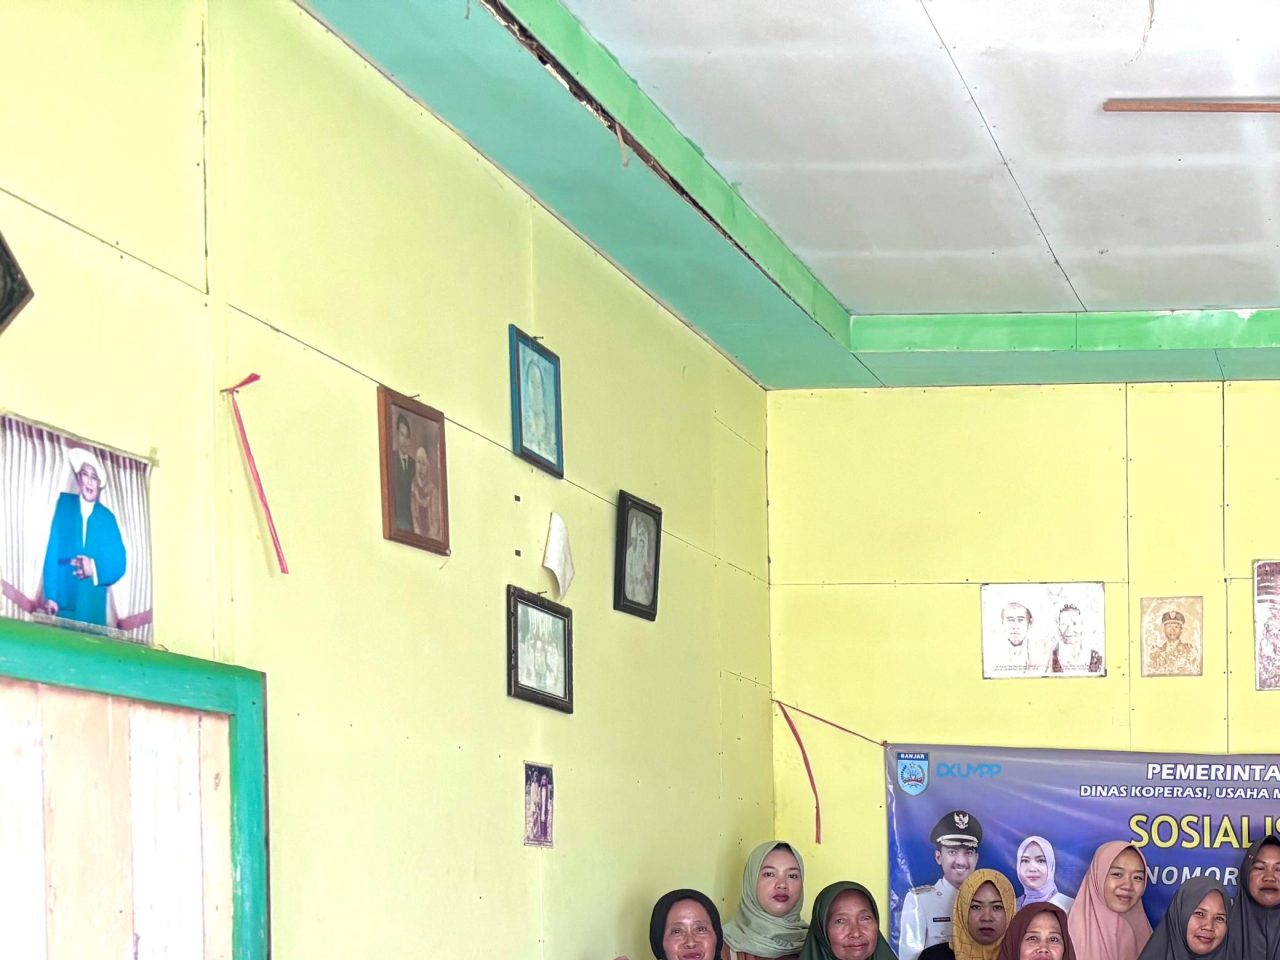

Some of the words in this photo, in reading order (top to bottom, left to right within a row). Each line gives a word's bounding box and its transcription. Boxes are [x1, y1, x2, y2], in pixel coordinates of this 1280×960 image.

[1080, 785, 1128, 797] DINAS
[1131, 786, 1212, 800] KOPERASI,
[1216, 787, 1270, 799] USAHA
